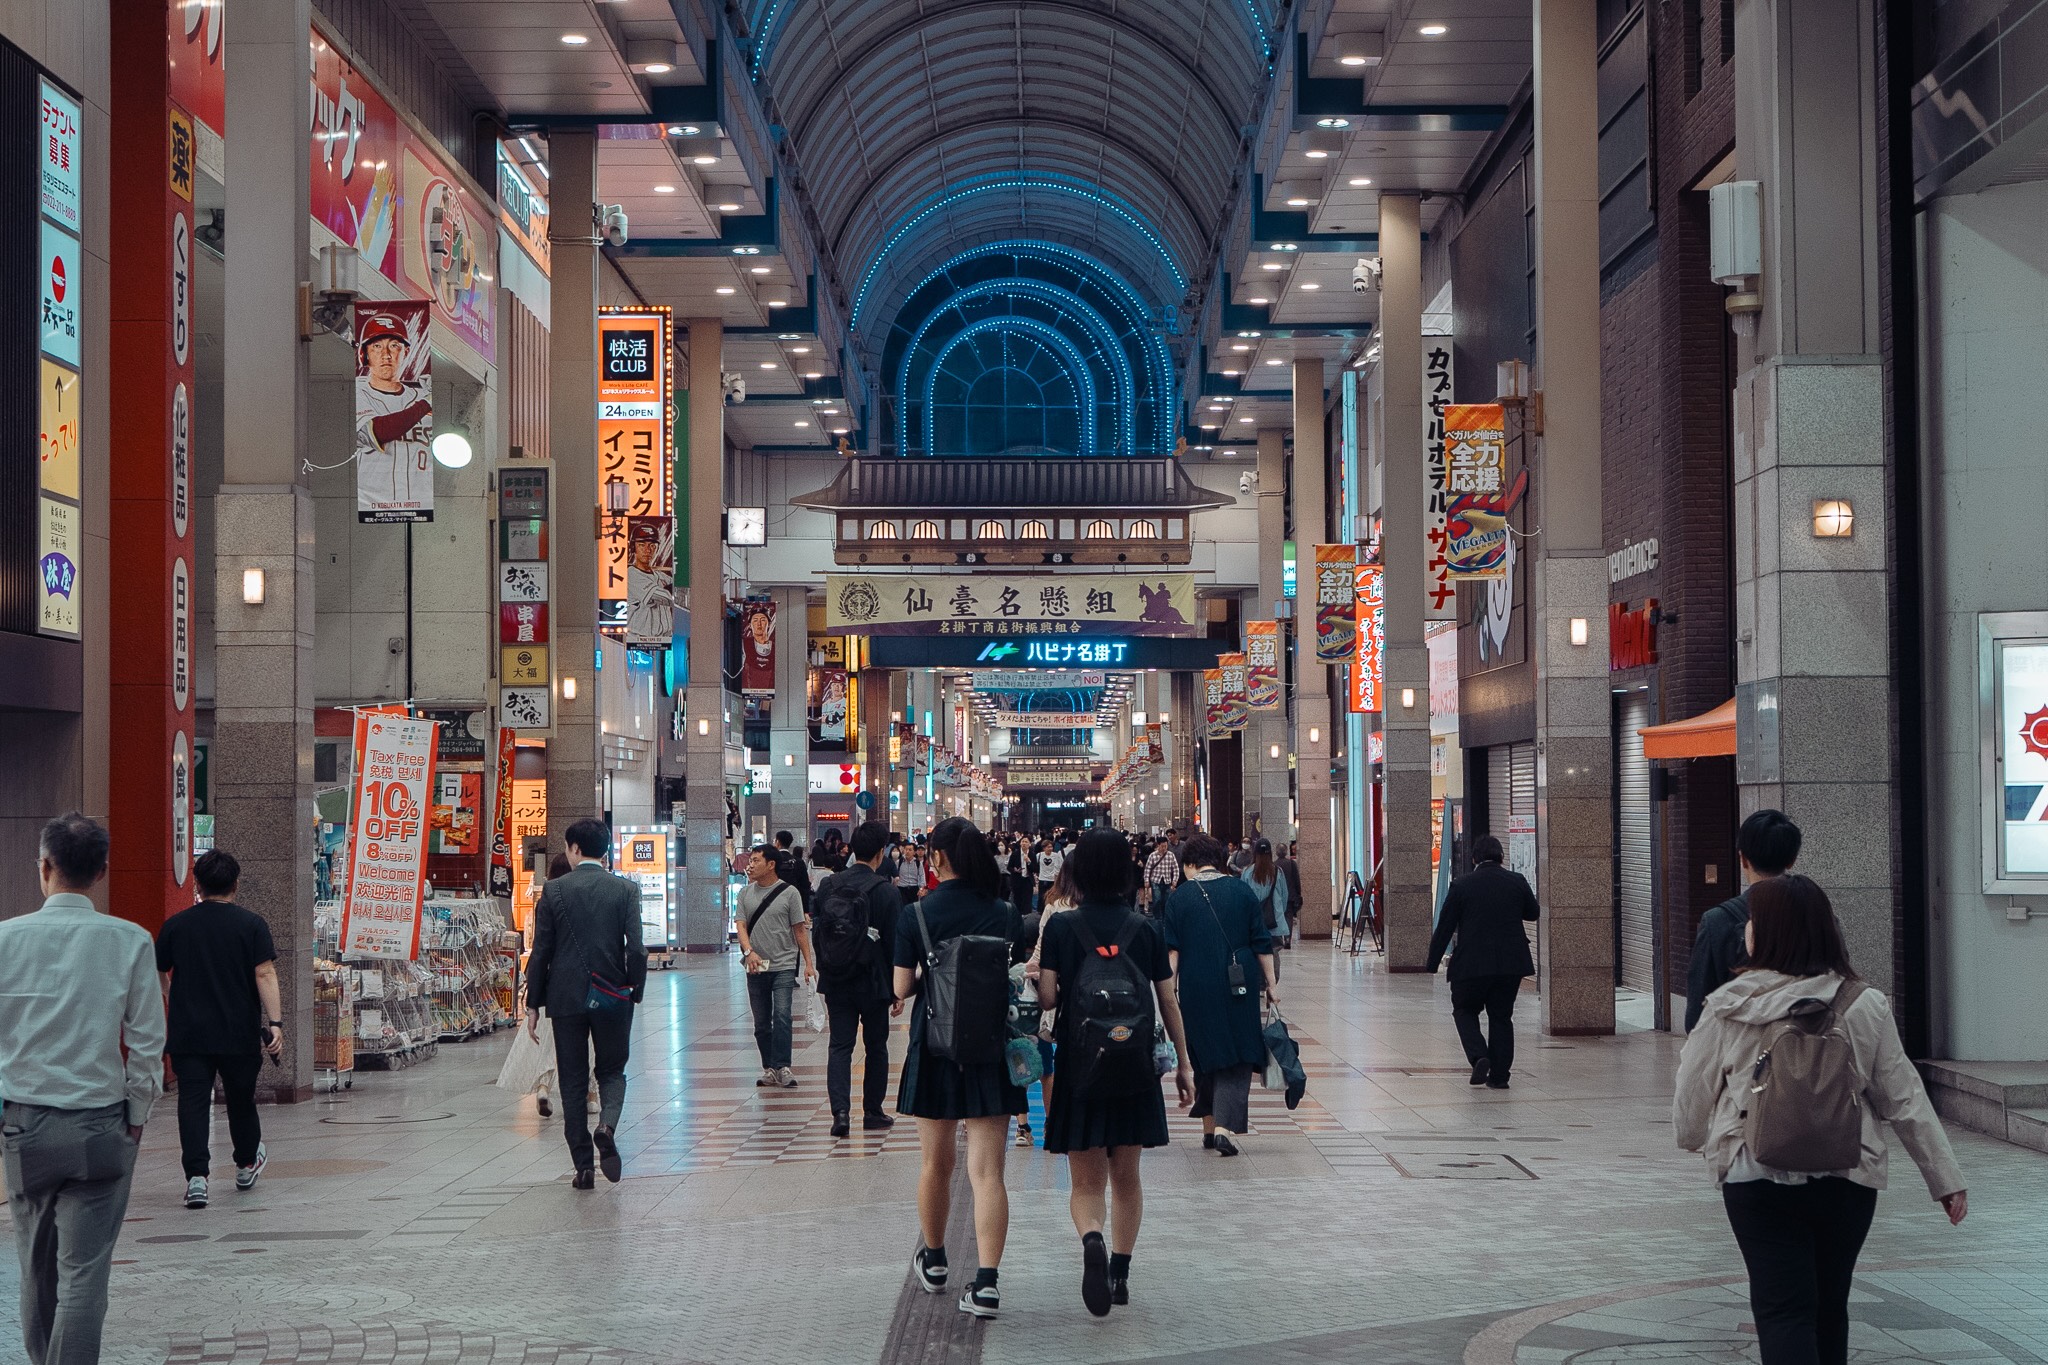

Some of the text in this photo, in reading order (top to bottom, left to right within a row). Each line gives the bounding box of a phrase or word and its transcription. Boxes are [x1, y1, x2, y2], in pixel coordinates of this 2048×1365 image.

[43, 98, 76, 139] テナント
[49, 135, 70, 173] 募集
[172, 119, 190, 192] 薬
[174, 226, 188, 352] くすり
[609, 339, 647, 358] 快活
[610, 359, 647, 373] CLUB
[605, 404, 654, 417] 24h OPEN
[40, 418, 78, 462] こってり
[175, 400, 188, 522] 化粧品
[1451, 442, 1501, 467] 全力
[632, 430, 654, 517] コミック
[1451, 466, 1501, 492] 応援
[515, 489, 533, 499] ビル
[604, 429, 626, 588] インネット
[1319, 570, 1353, 588] 全力
[903, 584, 1117, 617] 仙臺名懸組
[1319, 587, 1354, 605] 応援
[518, 604, 534, 642] 串屋
[938, 620, 1082, 634] 名掛丁商店街振興組合
[175, 574, 187, 693] 日用品
[1027, 642, 1128, 662] ハピナ名掛丁
[1249, 640, 1275, 653] 全力
[1249, 653, 1276, 667] 応援
[512, 667, 538, 679] 大福
[1083, 675, 1103, 685] NO!
[1222, 670, 1244, 682] 全力
[1222, 680, 1245, 693] 応援
[1053, 714, 1094, 724] ポイ捨て禁止
[370, 749, 427, 766] Tax Free
[398, 766, 422, 781] 면세
[175, 762, 187, 853] 食品
[365, 780, 420, 820] 10%
[365, 817, 418, 842] OFF
[635, 843, 652, 852] 快活
[359, 862, 416, 882] Welcome
[355, 882, 415, 903] 欢迎光临
[352, 901, 413, 923] 어서 오십시오
